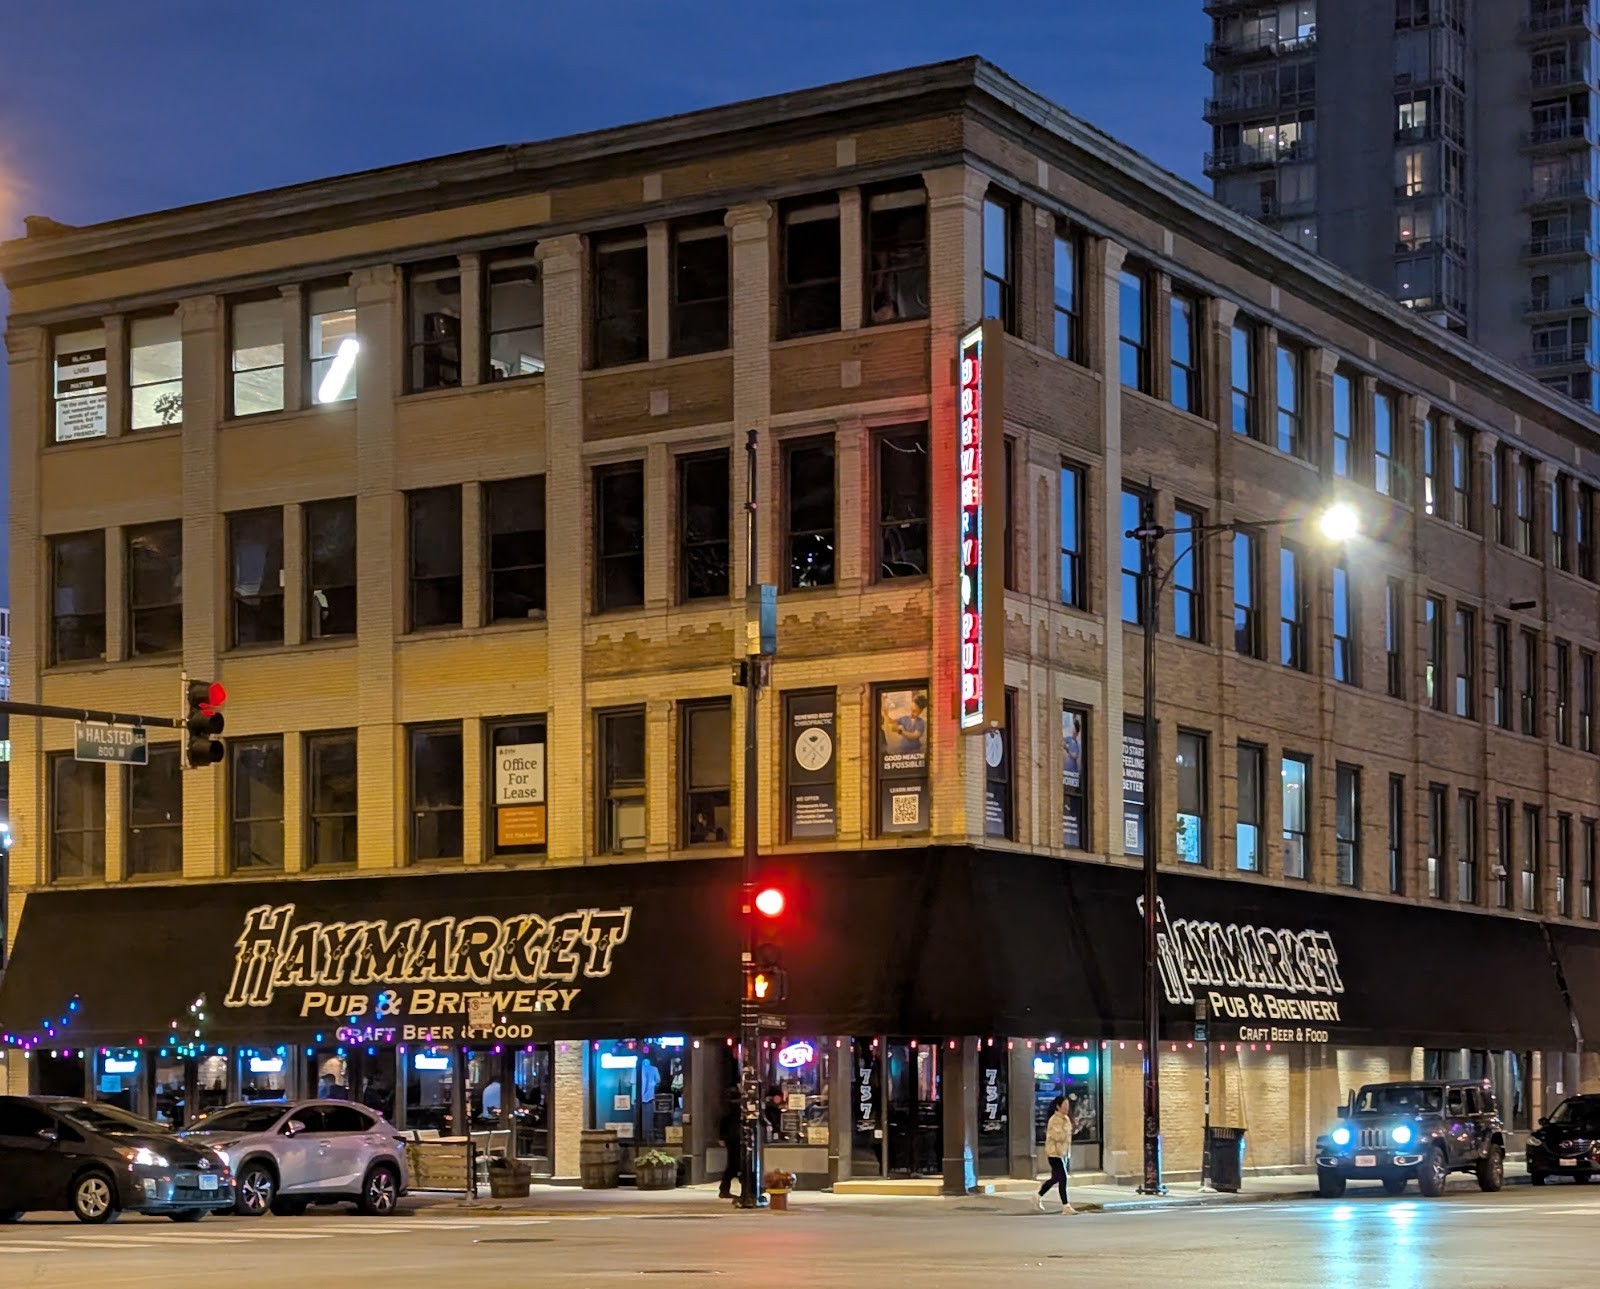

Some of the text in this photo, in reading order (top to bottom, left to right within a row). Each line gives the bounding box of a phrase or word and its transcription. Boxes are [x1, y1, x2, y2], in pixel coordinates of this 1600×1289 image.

[961, 358, 976, 700] BREWERY PUB
[86, 728, 133, 745] HALSTED
[98, 746, 125, 757] 800 W
[1129, 746, 1144, 757] START
[503, 758, 537, 771] Office
[884, 760, 925, 770] IS POSSIBLE!
[1122, 755, 1145, 769] FEELING
[508, 773, 529, 785] For
[1122, 779, 1144, 792] BETTER
[503, 787, 537, 799] Lease
[224, 903, 633, 1008] HAYMARKET
[1137, 895, 1345, 1005] HAYMARKET
[299, 991, 370, 1017] PUB
[376, 990, 401, 1016] &
[1208, 991, 1341, 1021] PUB & BREWERY
[336, 1025, 396, 1041] CRAFT
[403, 1025, 455, 1040] BEER
[1239, 1026, 1328, 1042] CRAFT BEER & FOOD
[859, 1069, 872, 1119] 737
[985, 1069, 998, 1119] 737
